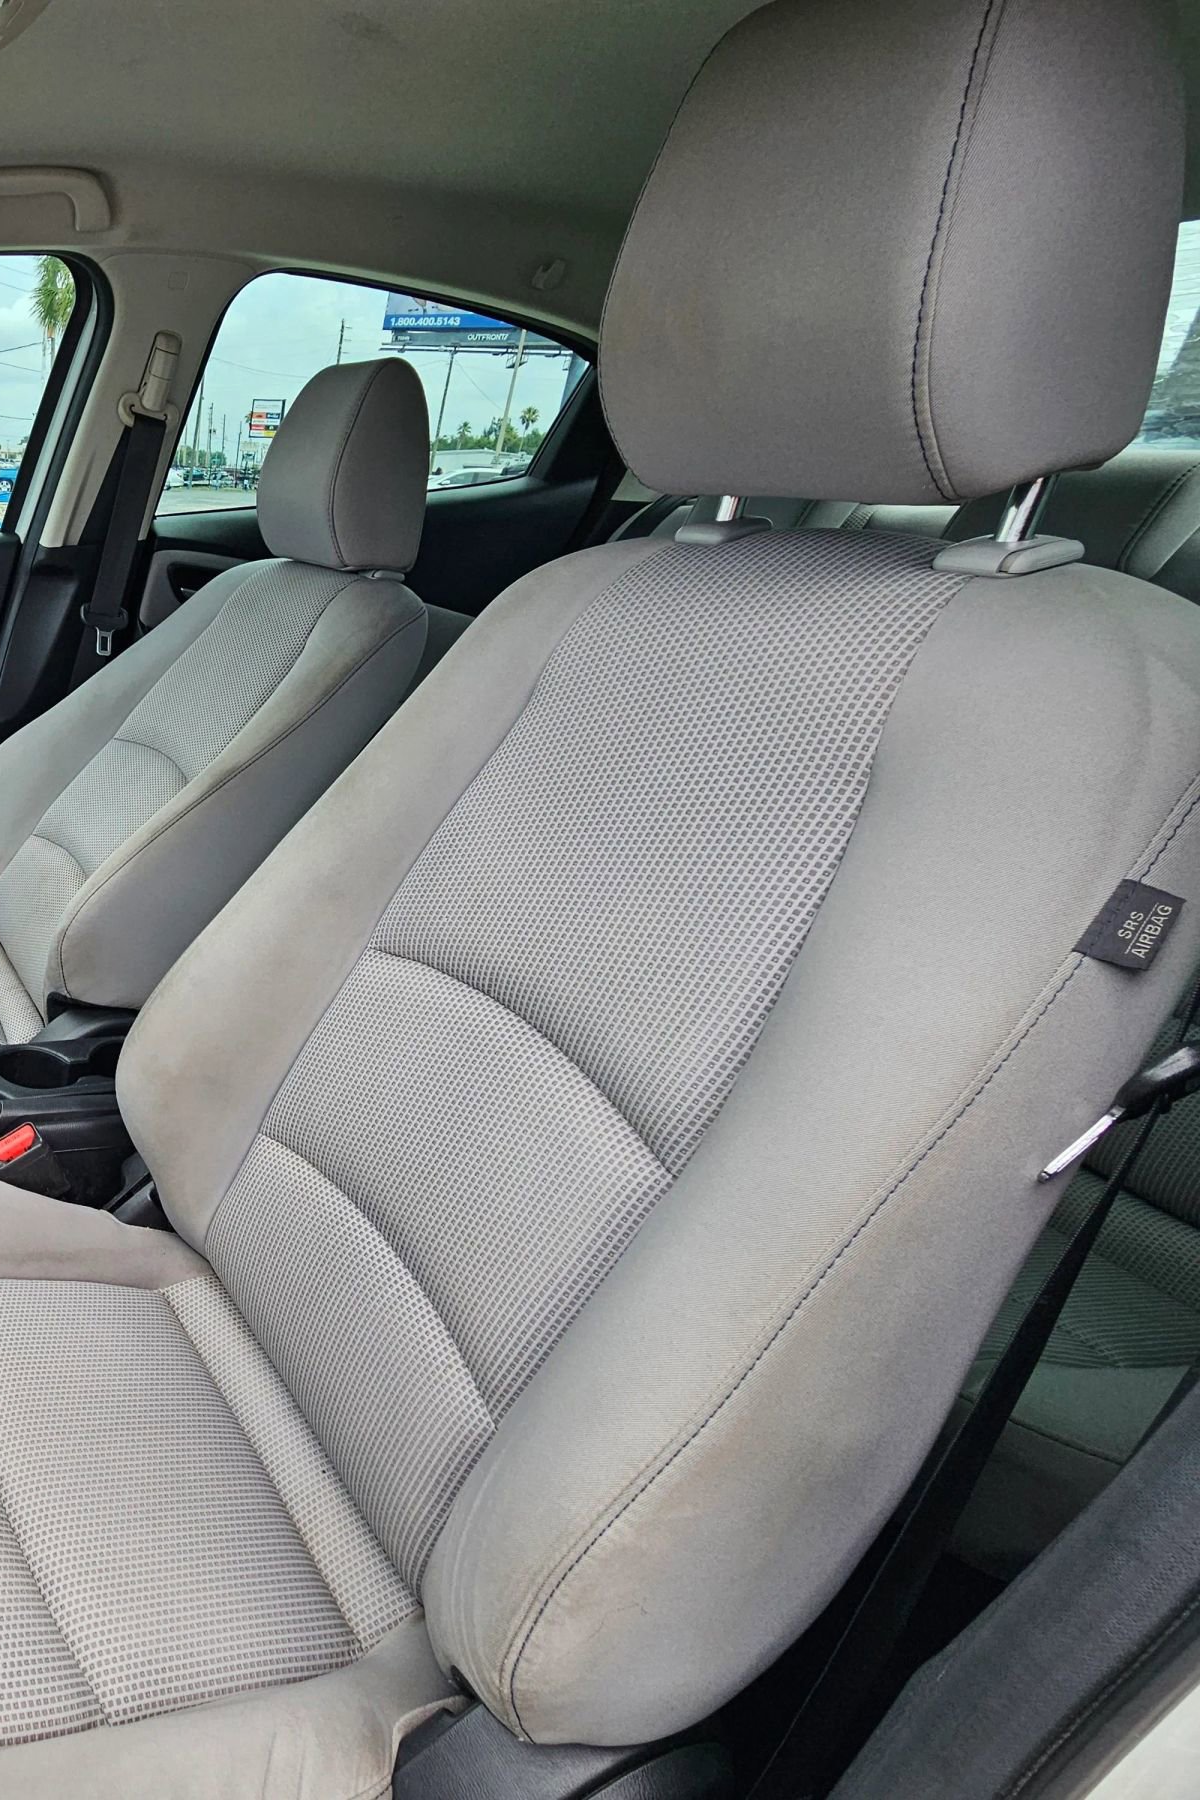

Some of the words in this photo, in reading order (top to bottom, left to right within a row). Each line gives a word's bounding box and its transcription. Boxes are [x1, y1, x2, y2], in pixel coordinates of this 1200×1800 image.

[390, 316, 461, 327] 1.800.400.5143
[1118, 911, 1145, 939] SRS
[1131, 904, 1173, 959] AIRBAG
